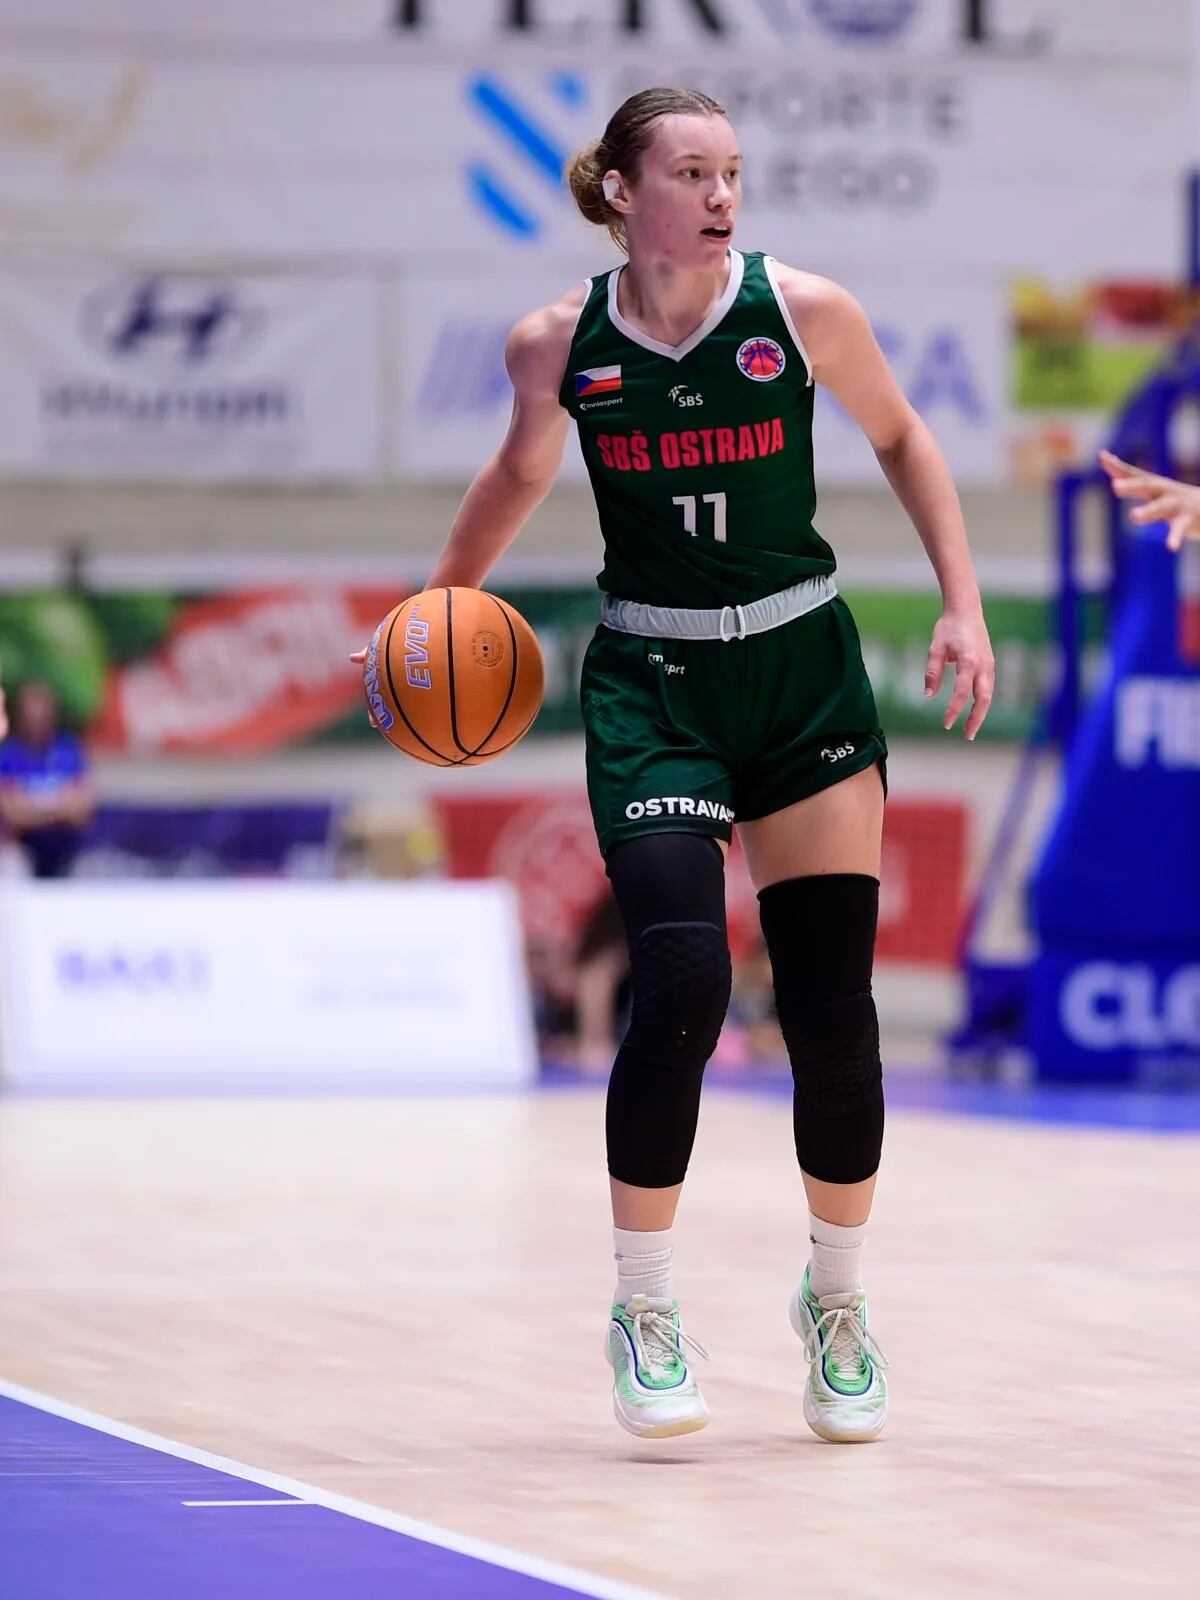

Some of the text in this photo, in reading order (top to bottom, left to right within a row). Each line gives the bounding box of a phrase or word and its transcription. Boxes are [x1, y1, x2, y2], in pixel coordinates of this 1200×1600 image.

[678, 392, 704, 408] SBŠ
[597, 417, 785, 471] SBŠ OSTRAVA
[672, 492, 727, 543] 11
[405, 621, 432, 689] EVO
